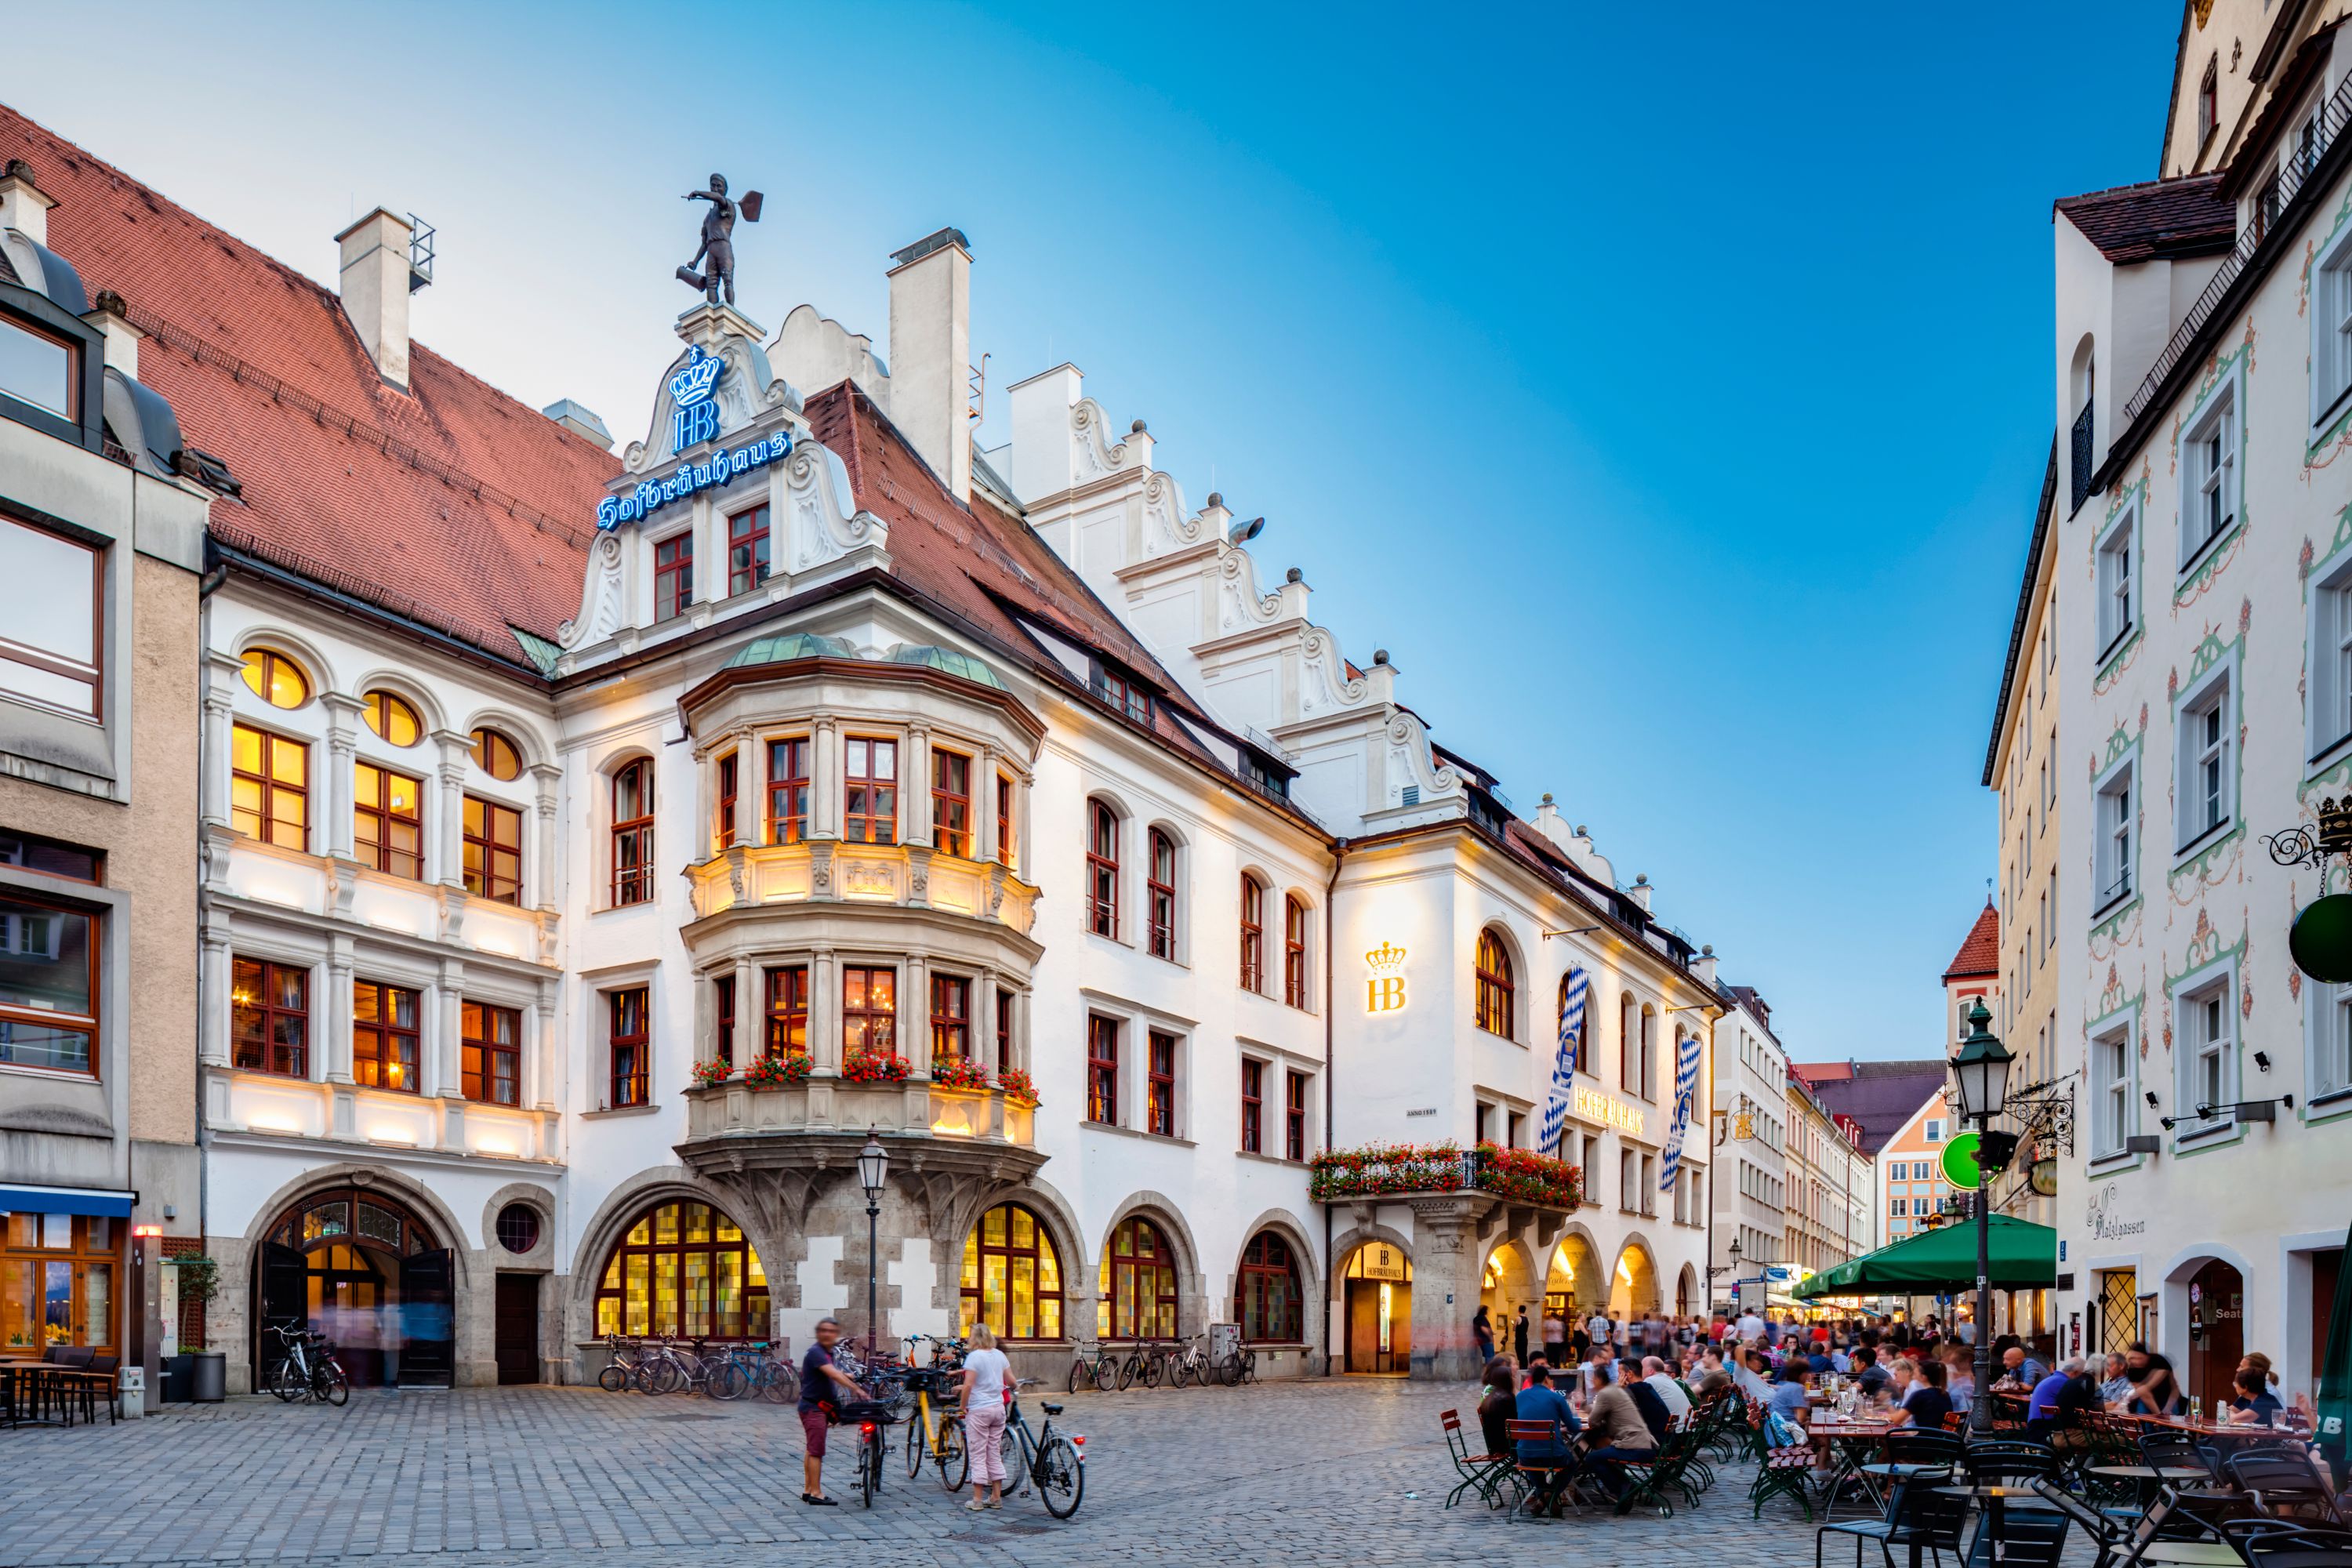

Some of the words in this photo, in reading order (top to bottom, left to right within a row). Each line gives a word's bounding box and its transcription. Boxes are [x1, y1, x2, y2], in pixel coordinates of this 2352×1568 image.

[673, 400, 717, 452] HB
[597, 431, 789, 531] Hofbräuhaus
[1367, 977, 1406, 1012] HB
[1577, 1087, 1644, 1134] HOFBRÄUHAUS
[1367, 1266, 1402, 1278] HOFBRÄUHAUS
[1380, 1250, 1389, 1266] HB
